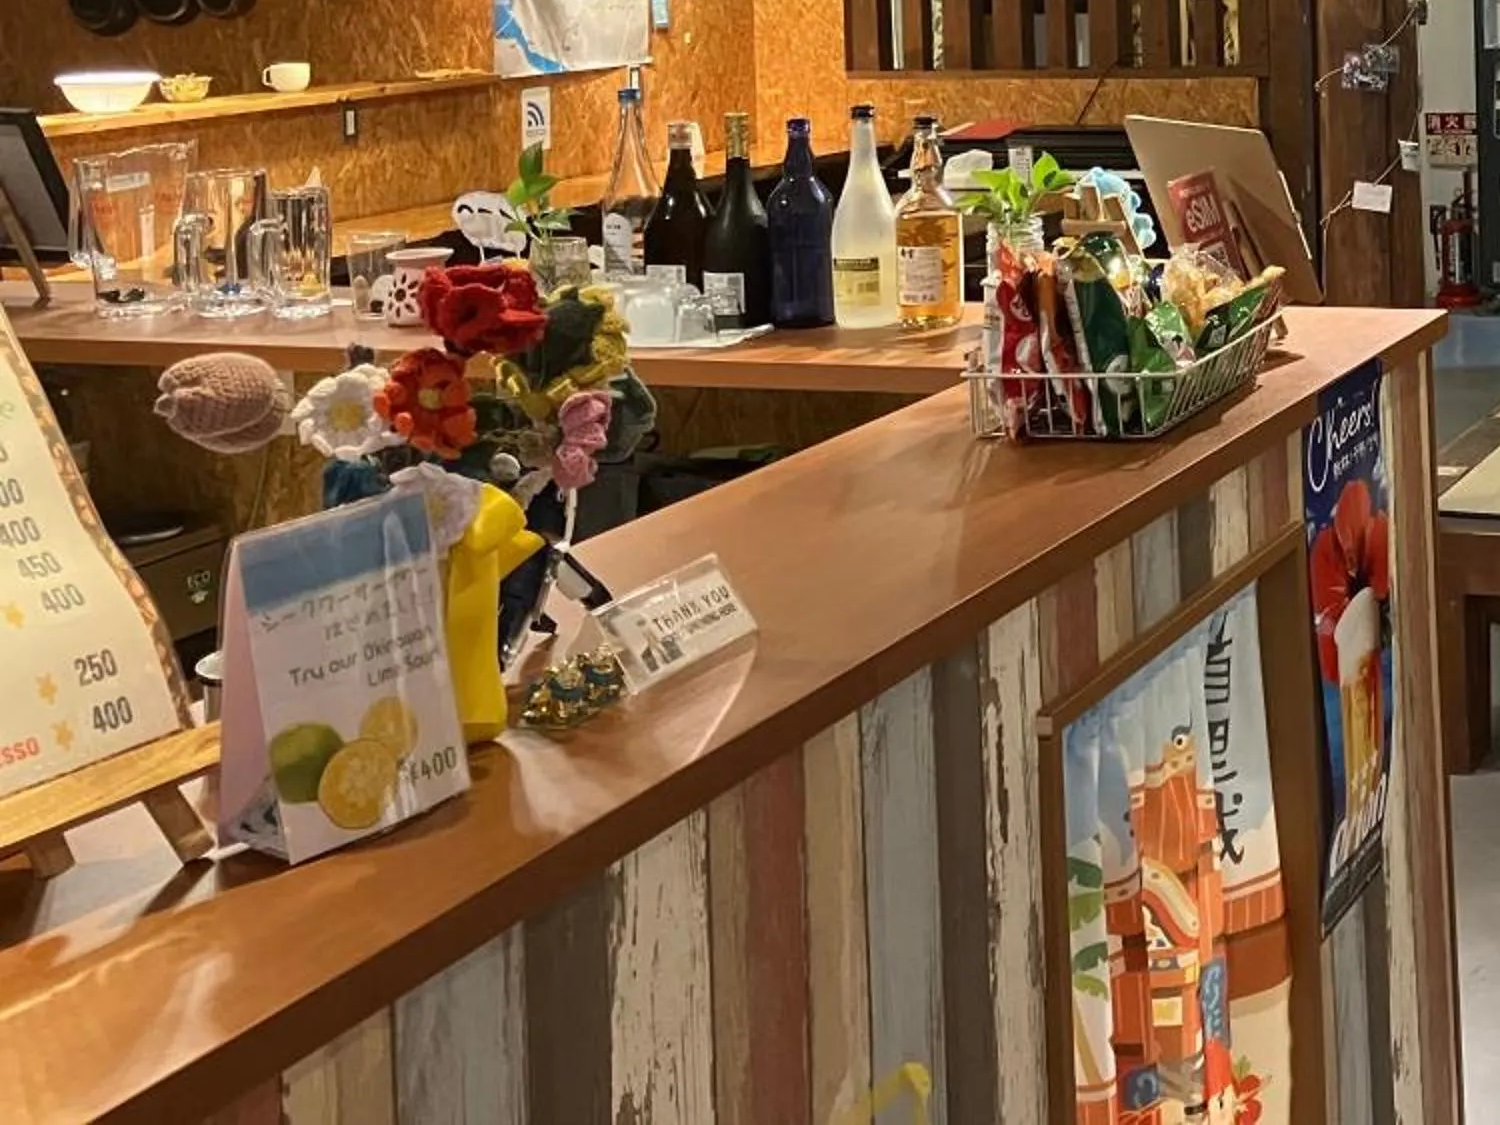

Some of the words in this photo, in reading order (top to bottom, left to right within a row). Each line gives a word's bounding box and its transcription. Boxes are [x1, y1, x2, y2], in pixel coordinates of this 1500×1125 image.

[16, 551, 62, 582] 450
[40, 583, 86, 616] 400
[74, 648, 119, 688] 250
[289, 666, 325, 687] Try
[328, 651, 358, 674] our
[92, 695, 133, 734] 400
